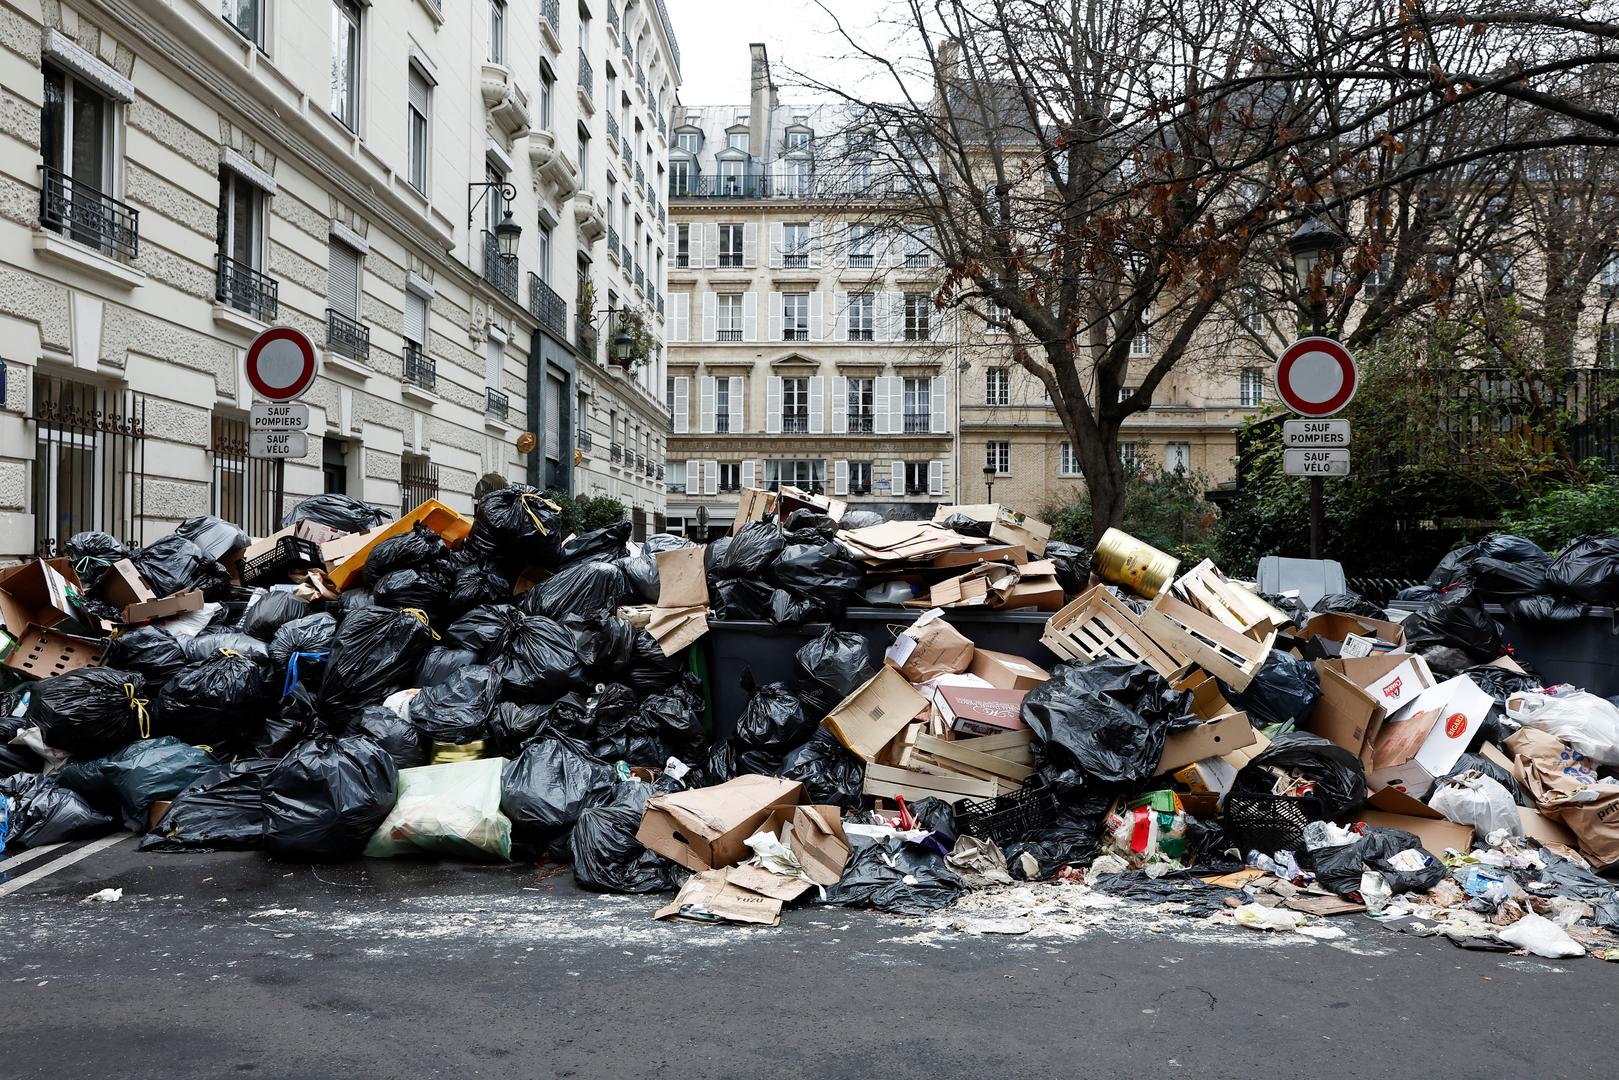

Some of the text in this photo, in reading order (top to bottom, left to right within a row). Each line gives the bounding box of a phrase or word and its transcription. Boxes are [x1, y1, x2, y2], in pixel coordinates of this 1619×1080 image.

[267, 407, 290, 415] SAUF
[255, 417, 302, 426] POMPIERS
[1304, 423, 1331, 432] SAUF
[266, 435, 290, 443] SAUF
[1290, 434, 1344, 442] POMPIERS
[266, 443, 290, 454] VÉLO
[1303, 453, 1331, 461] SAUF
[1303, 461, 1331, 472] VÉLO
[1447, 714, 1464, 736] BIGARD
[736, 896, 764, 904] YUZU
